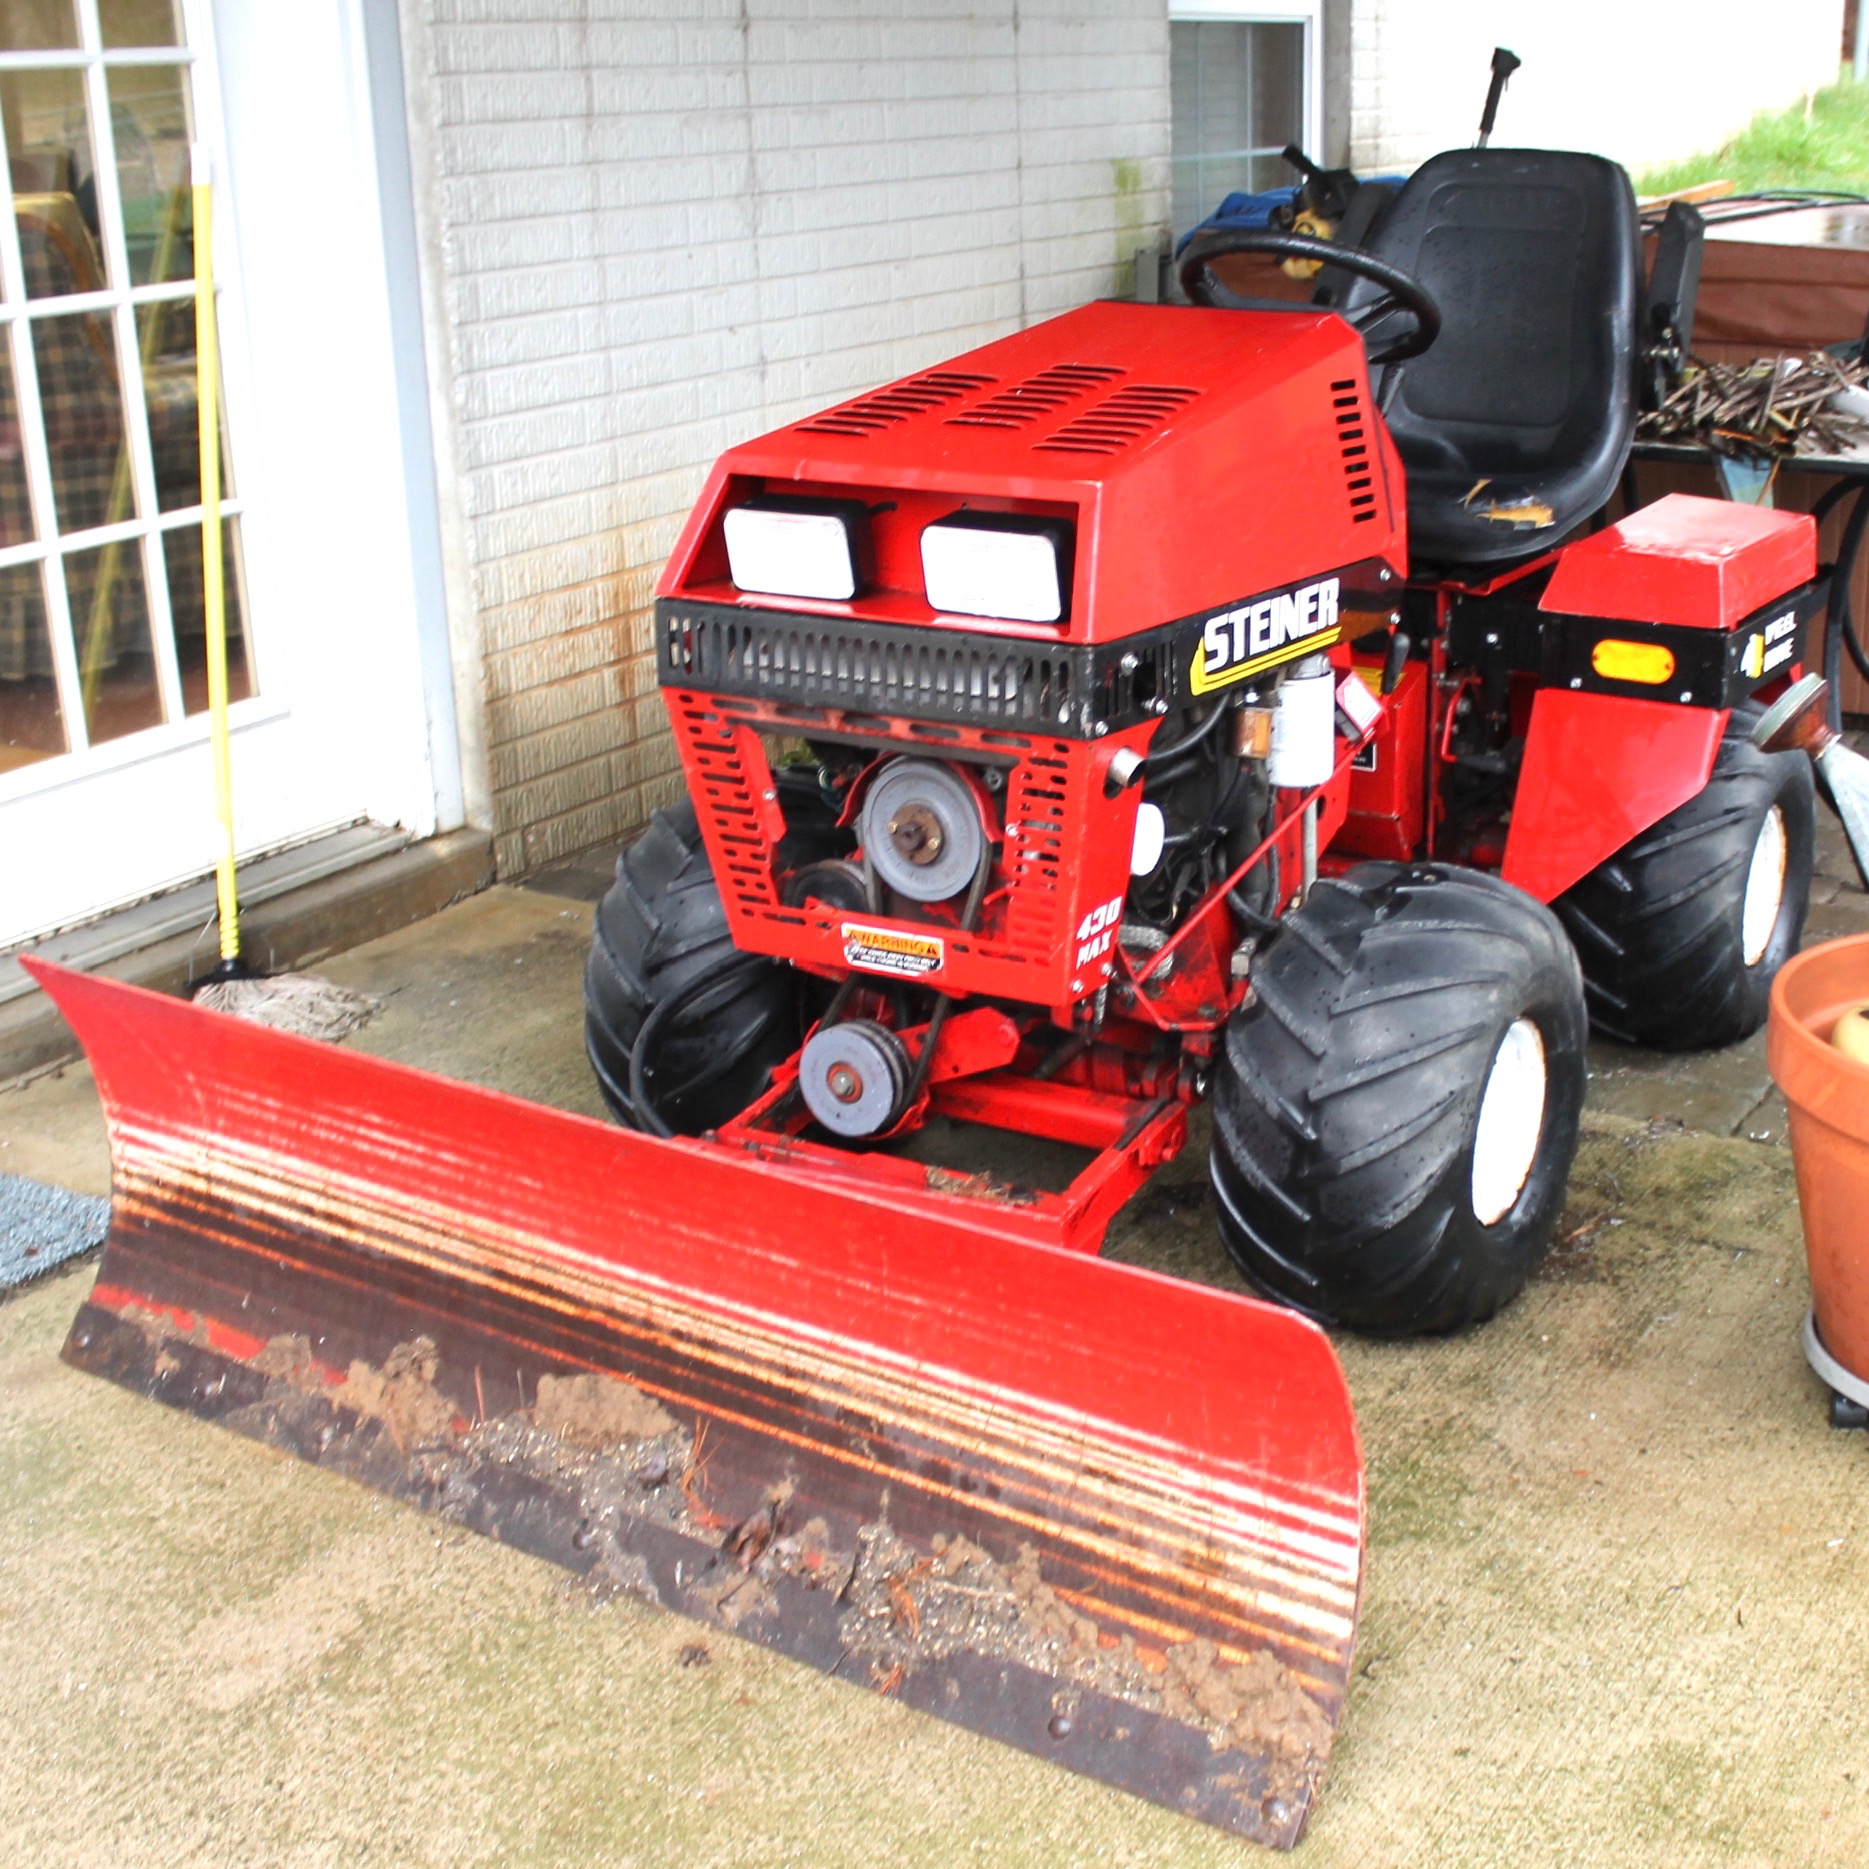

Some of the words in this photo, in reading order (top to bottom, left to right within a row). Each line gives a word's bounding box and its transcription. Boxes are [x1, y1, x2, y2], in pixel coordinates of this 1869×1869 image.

[1204, 577, 1340, 674] STEINER
[1076, 895, 1122, 942] 430
[859, 931, 924, 954] WARNING
[1076, 929, 1113, 971] MAX
